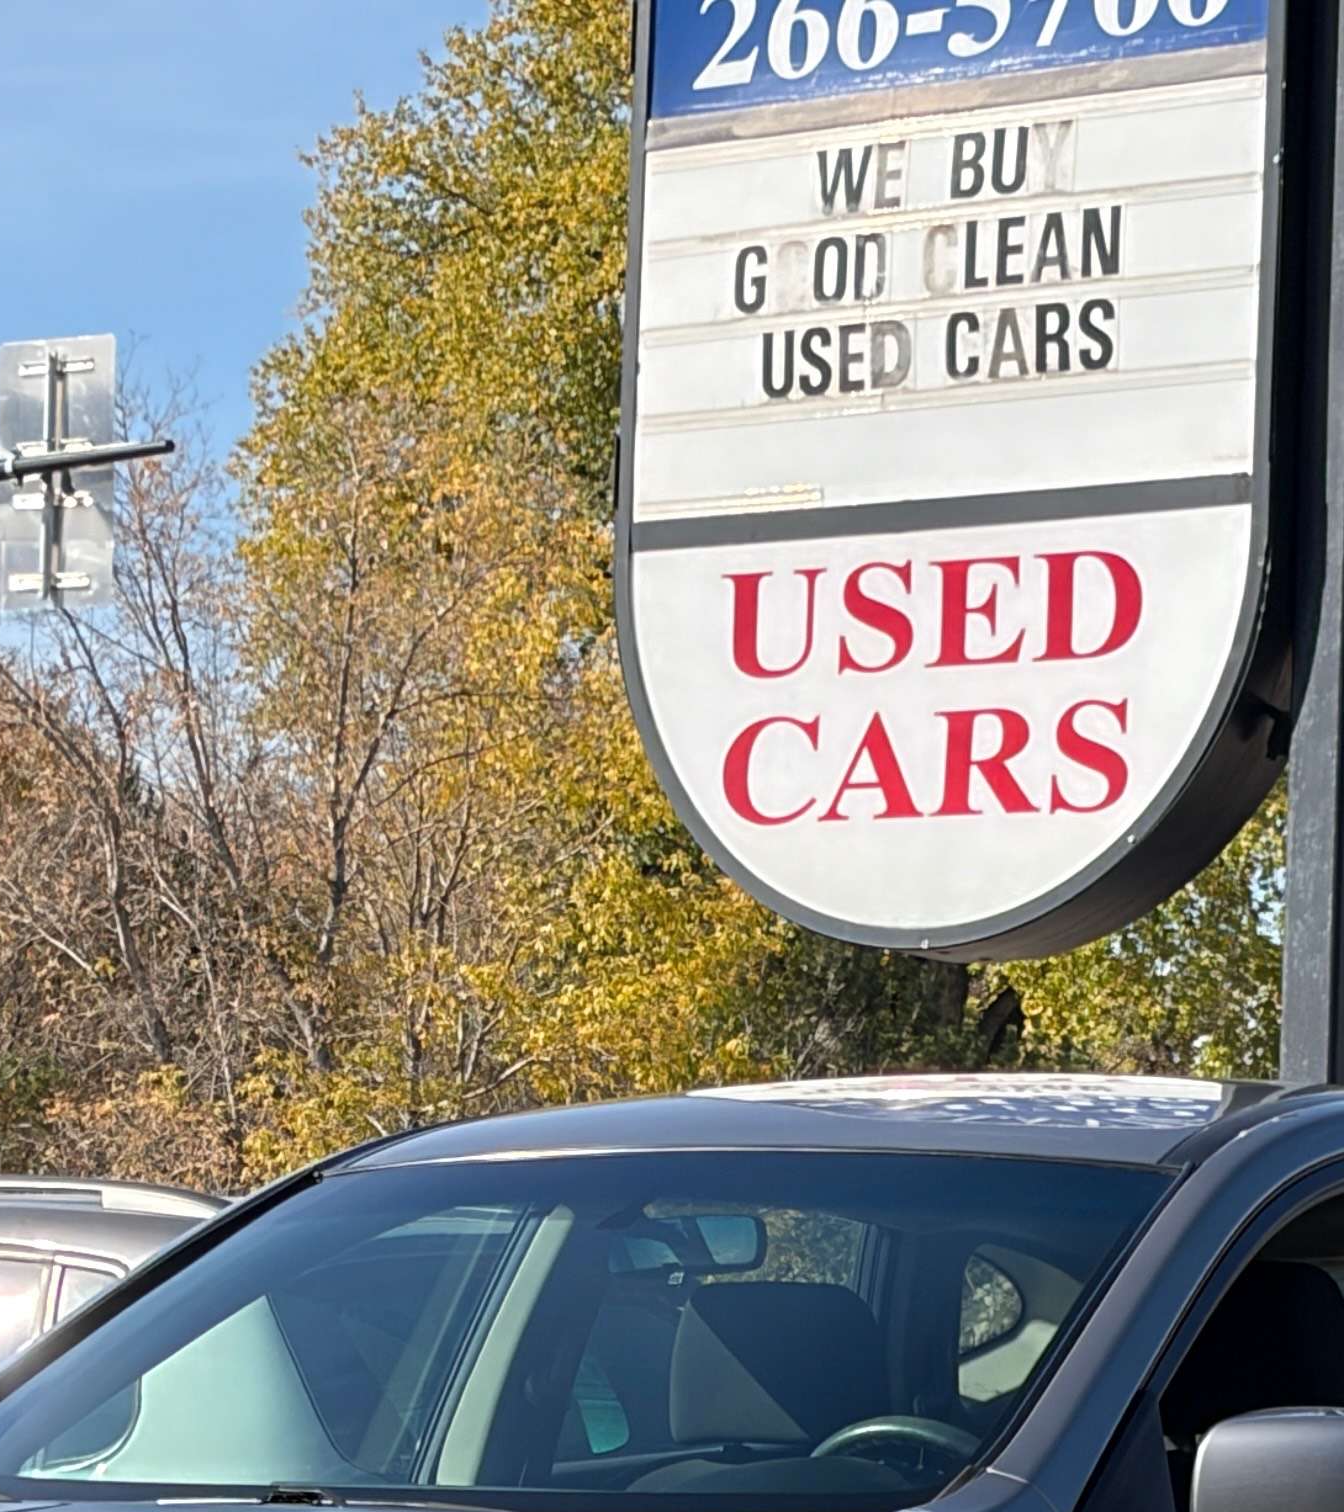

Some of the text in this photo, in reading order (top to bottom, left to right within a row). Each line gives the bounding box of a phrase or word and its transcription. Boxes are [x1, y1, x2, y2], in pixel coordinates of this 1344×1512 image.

[692, 0, 1229, 91] 266-5
[816, 119, 1074, 215] WE BUY
[922, 204, 1123, 298] CLEAN
[761, 298, 1115, 399] USED CARS
[721, 550, 1144, 679] USED
[721, 697, 1130, 827] CARS
